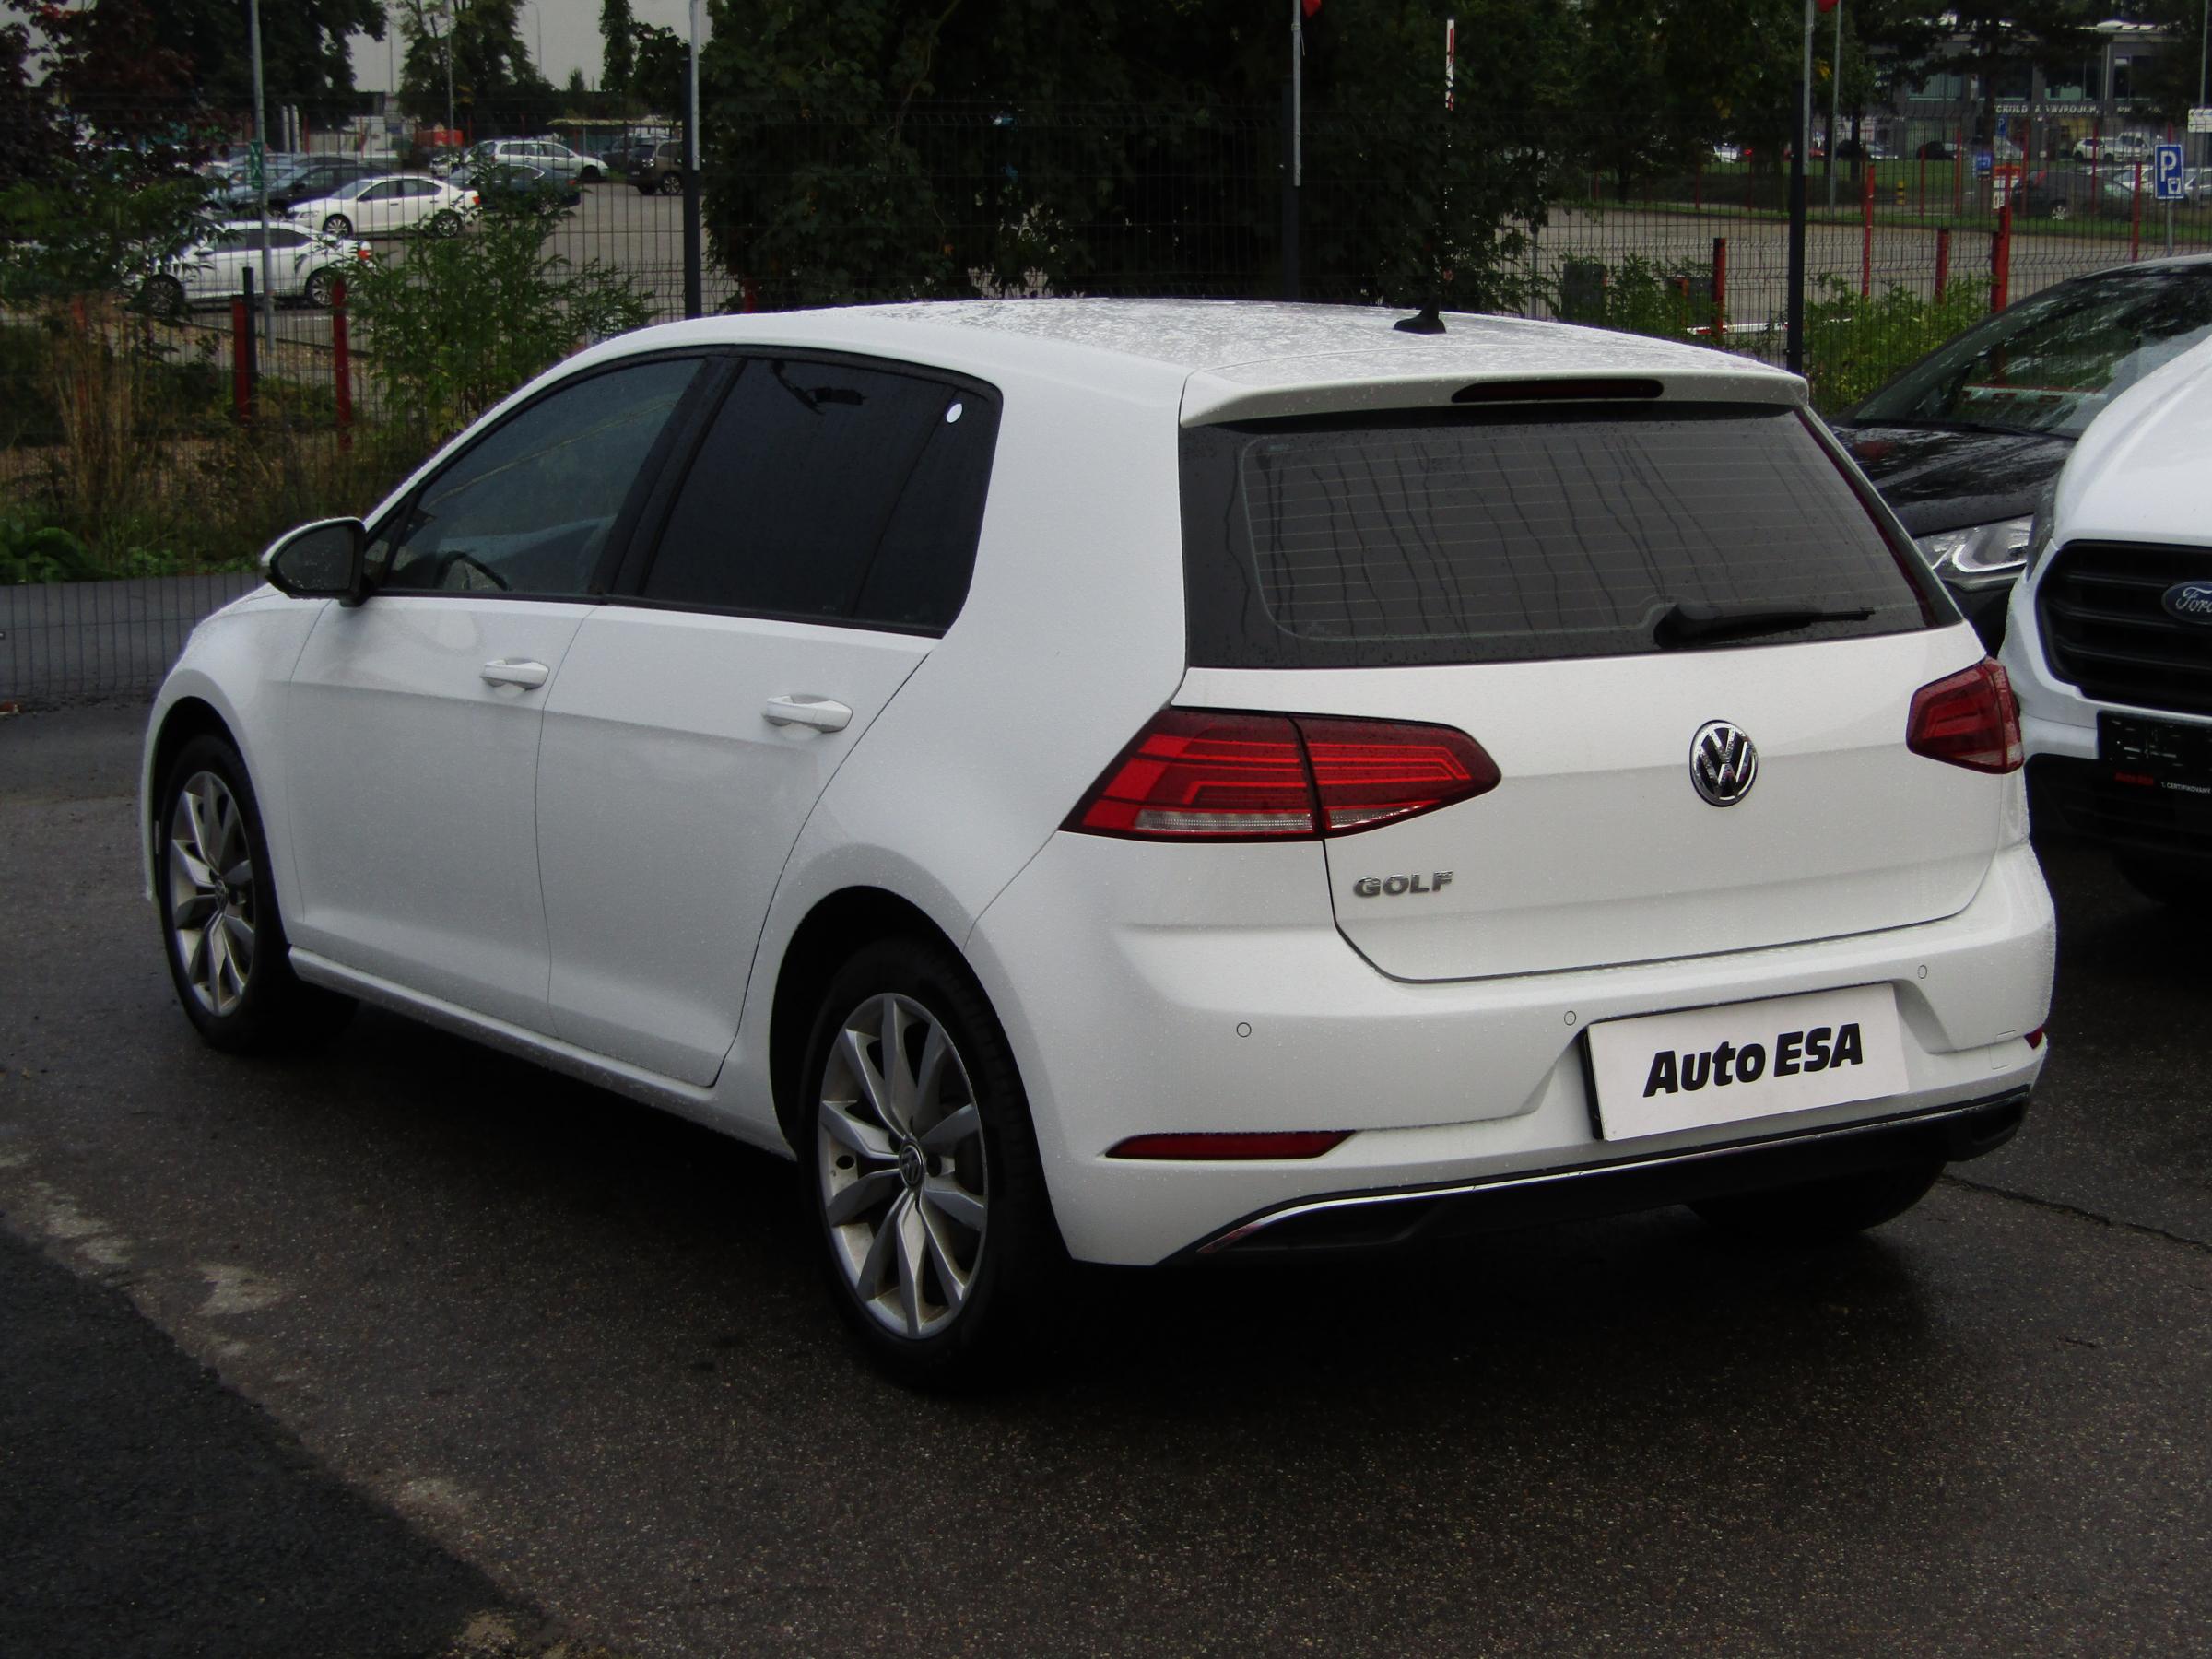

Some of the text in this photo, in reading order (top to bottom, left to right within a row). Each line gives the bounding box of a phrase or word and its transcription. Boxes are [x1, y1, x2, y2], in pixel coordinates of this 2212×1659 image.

[2160, 150, 2177, 182] P
[1353, 869, 1453, 898] GOLF
[1642, 1022, 1864, 1098] Auto ESA
